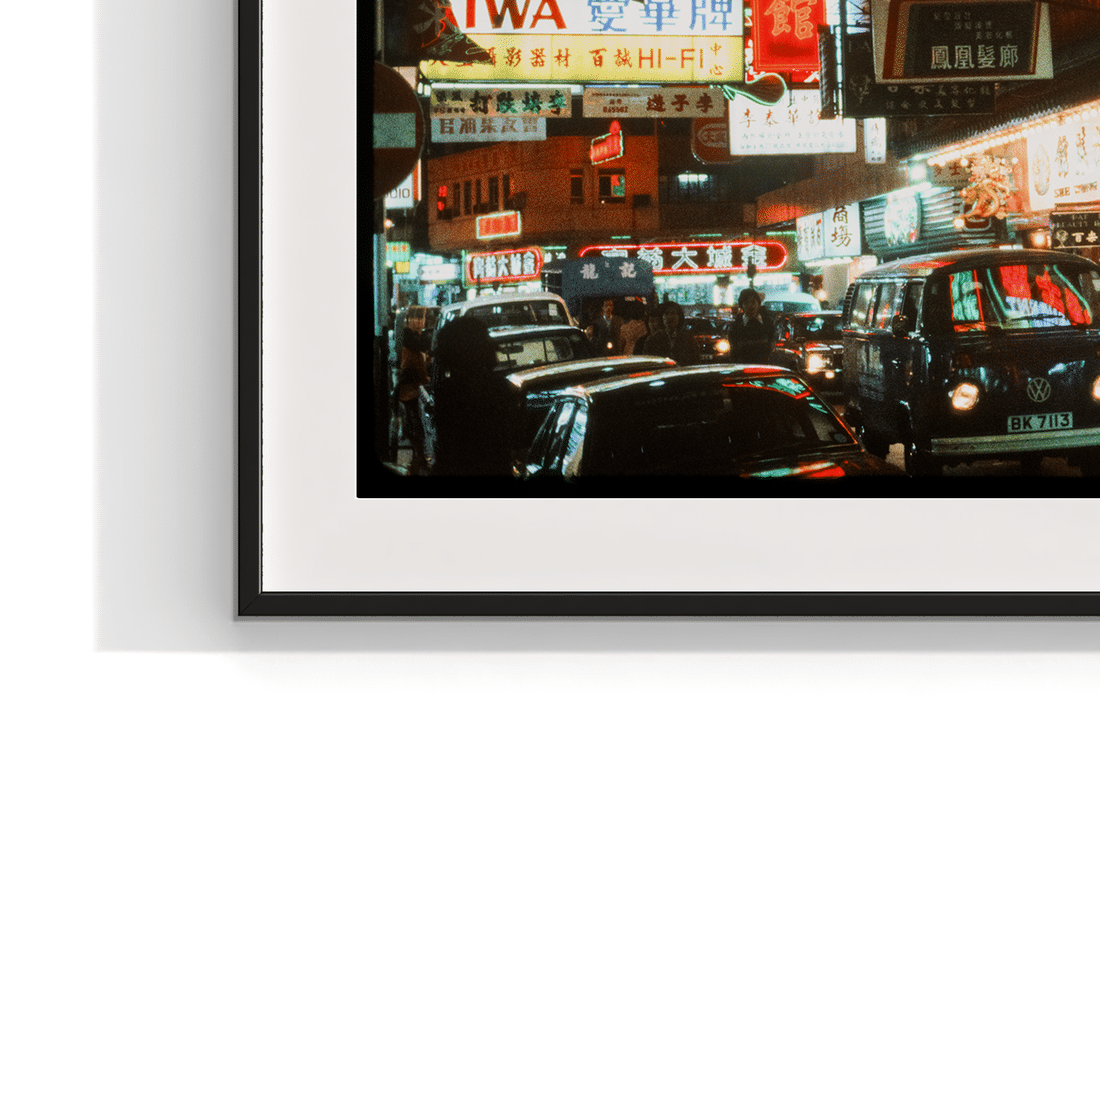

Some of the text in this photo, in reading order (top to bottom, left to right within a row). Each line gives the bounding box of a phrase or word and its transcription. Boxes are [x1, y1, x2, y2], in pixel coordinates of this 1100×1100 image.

[930, 44, 1018, 69] 鳳凰髮廊
[385, 187, 411, 199] DIO
[831, 205, 852, 247] 商場
[1011, 413, 1070, 430] BK 7113
